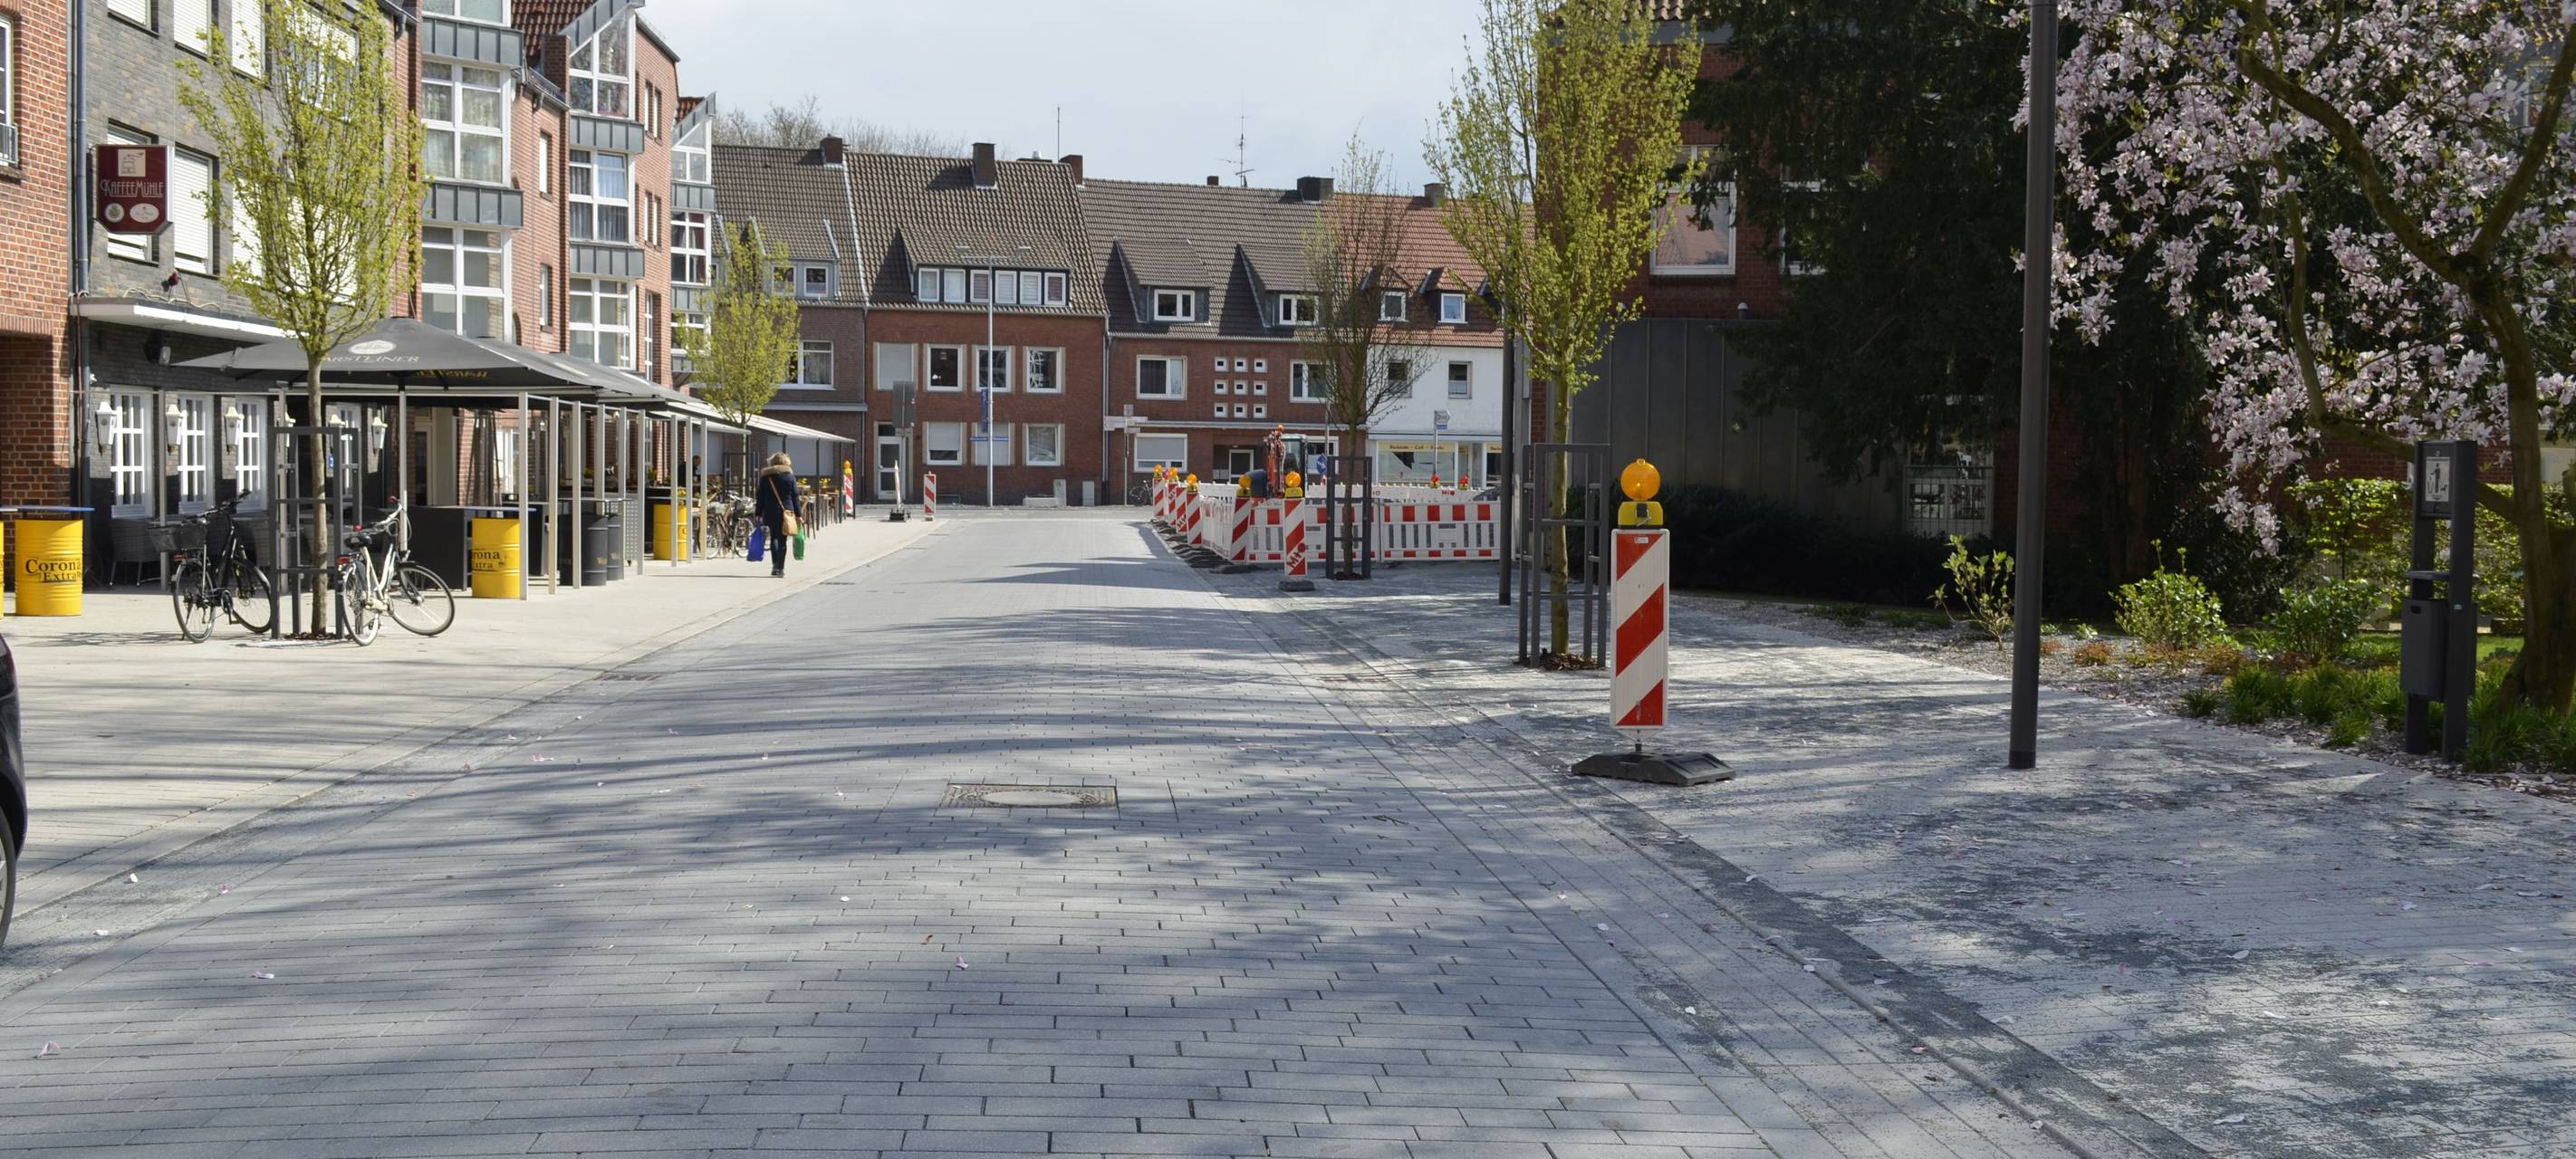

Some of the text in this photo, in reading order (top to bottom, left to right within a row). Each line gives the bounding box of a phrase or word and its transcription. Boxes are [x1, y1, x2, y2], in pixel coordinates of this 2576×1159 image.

[322, 355, 420, 363] ARSTEINER
[472, 550, 501, 560] rona
[25, 558, 82, 574] Corona
